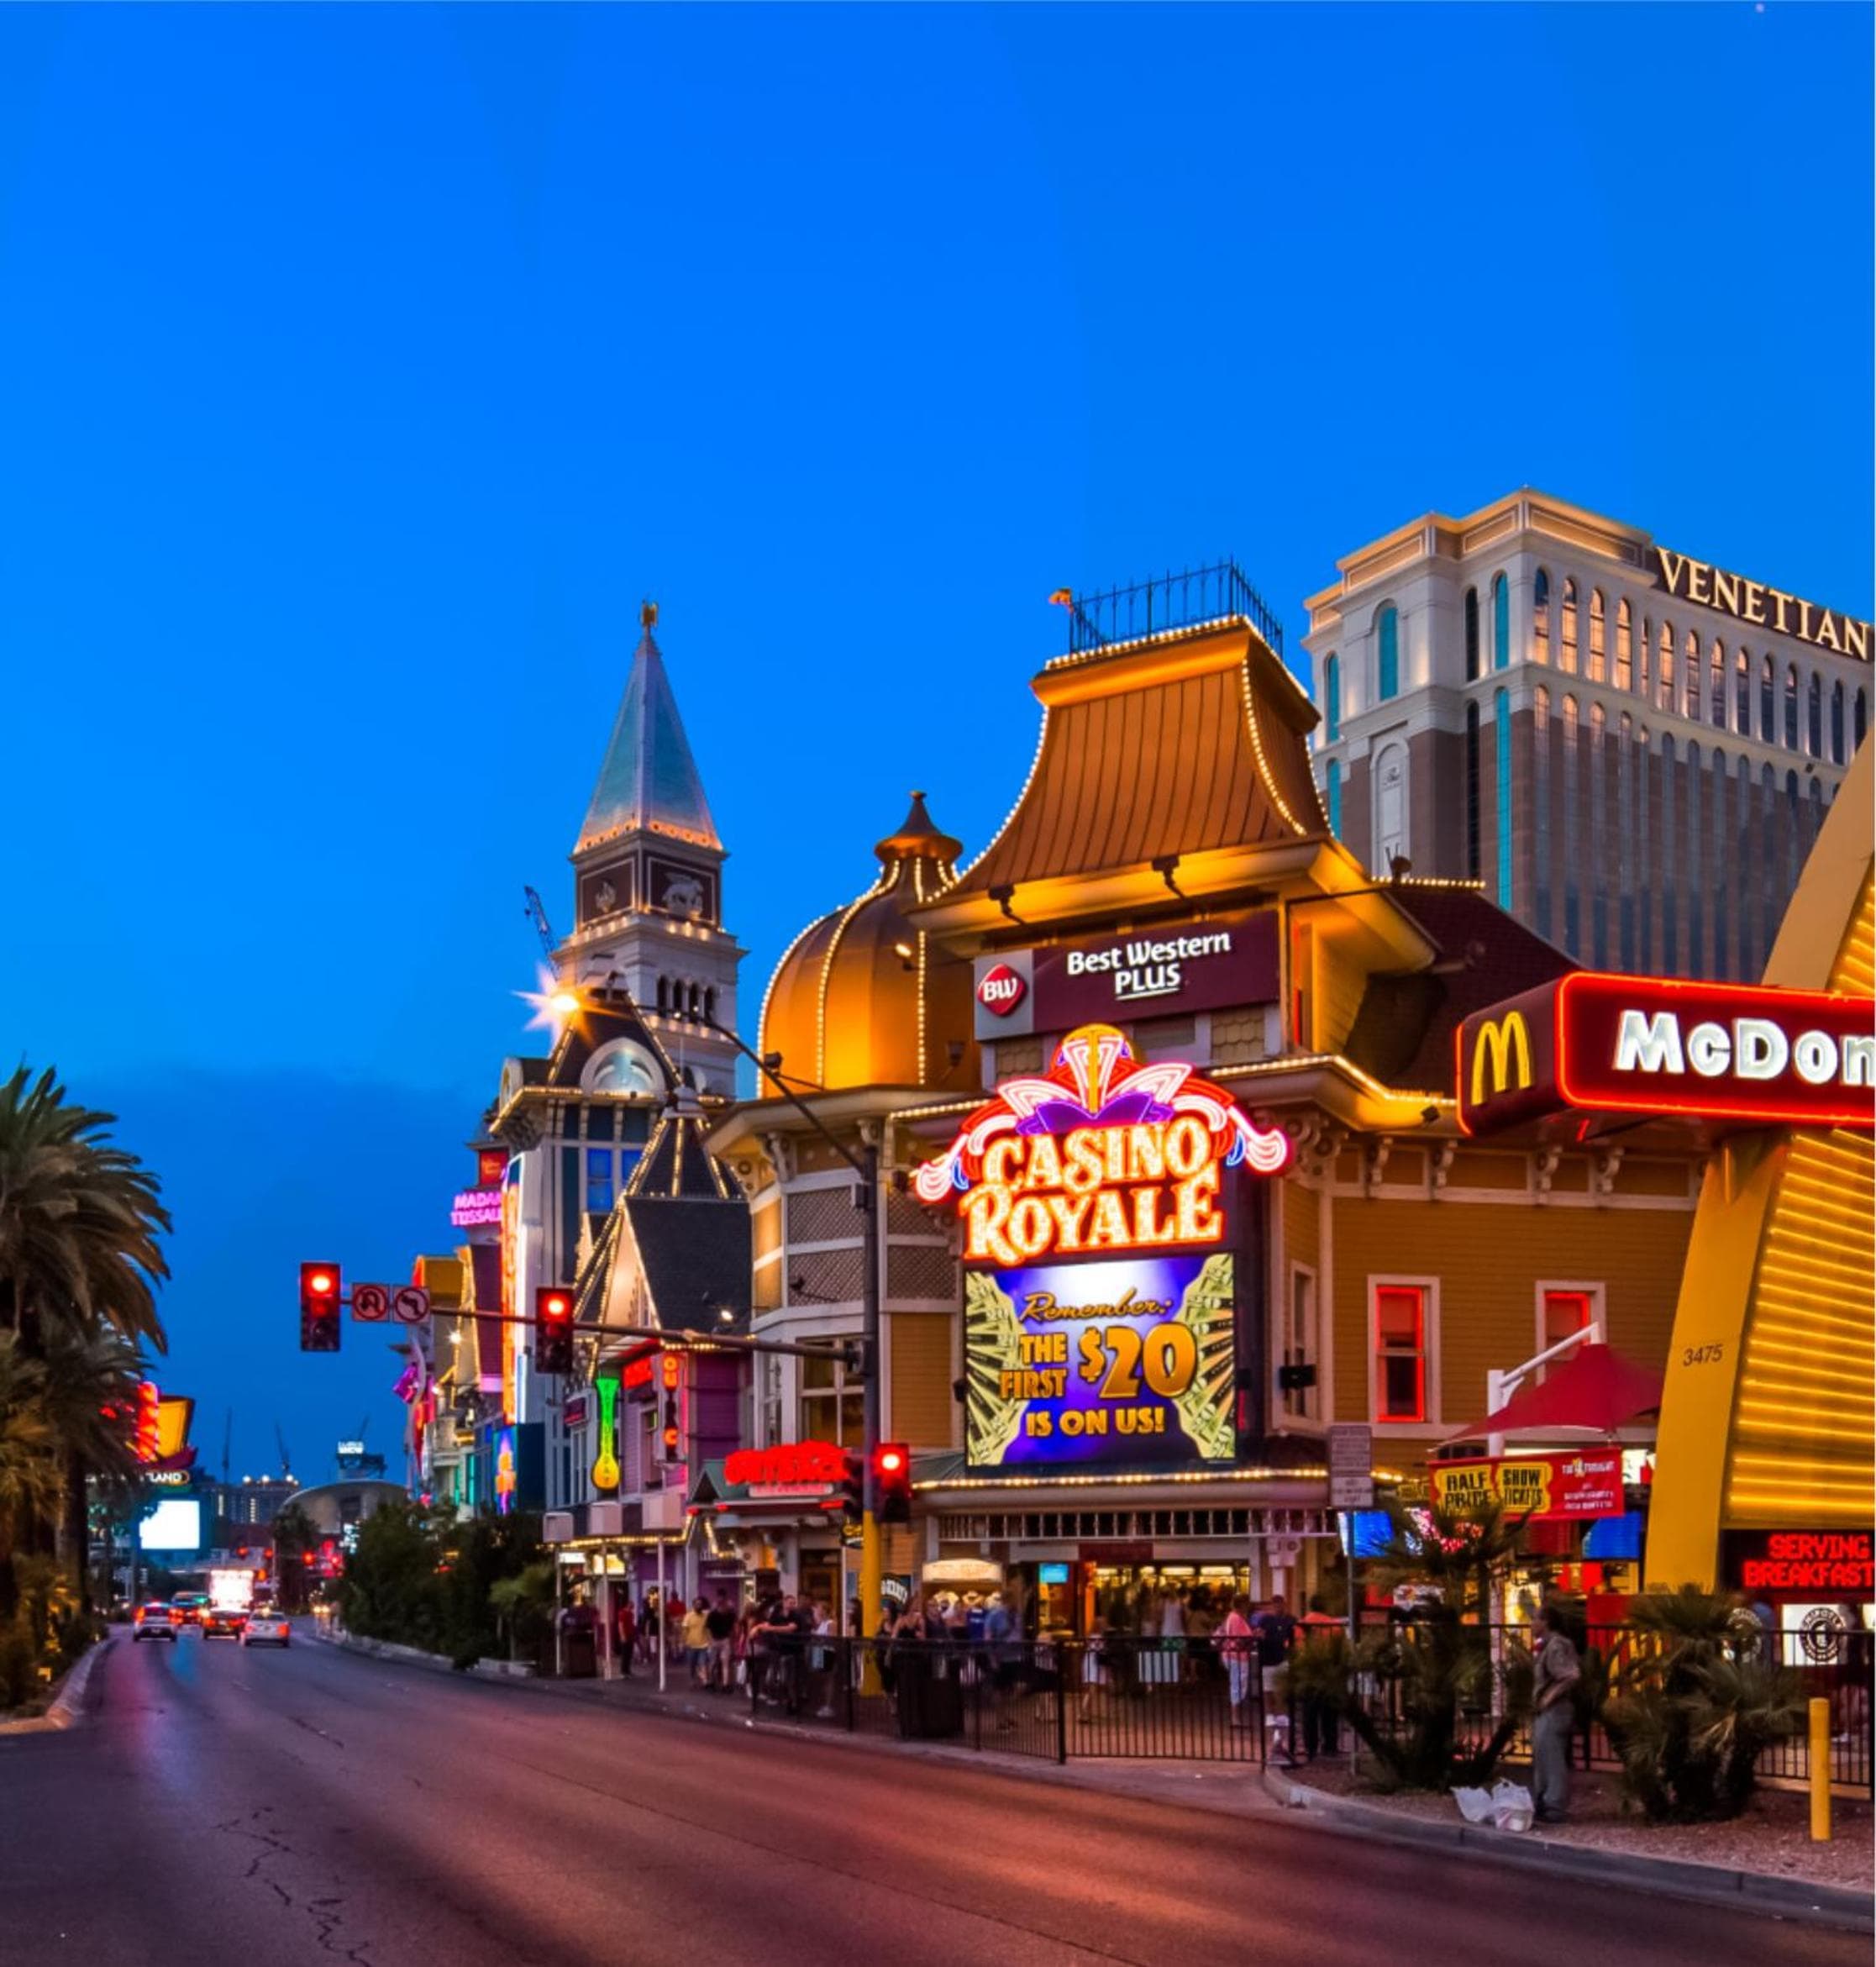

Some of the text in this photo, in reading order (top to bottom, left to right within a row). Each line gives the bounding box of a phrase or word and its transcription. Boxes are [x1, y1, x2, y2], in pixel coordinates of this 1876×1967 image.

[1656, 546, 1870, 661] VENETIAN
[1068, 933, 1231, 975] Best Western
[983, 977, 1018, 1002] BW
[1115, 965, 1180, 994] PLUS
[1612, 1009, 1874, 1086] McDon
[981, 1116, 1211, 1193] CASINO
[961, 1161, 1223, 1265] ROYALE
[1019, 1333, 1068, 1365] THE
[1079, 1322, 1198, 1399] $20
[1684, 1344, 1723, 1367] 3475
[1000, 1368, 1068, 1399] FIRST
[1026, 1407, 1165, 1437] IS ON US!
[145, 1472, 182, 1484] LAND
[1447, 1471, 1488, 1491] HALF
[1502, 1469, 1540, 1483] SHOW
[1446, 1490, 1490, 1510] PRICE
[1503, 1488, 1542, 1507] TICKETS
[1768, 1533, 1870, 1559] SERVING
[1743, 1560, 1874, 1587] BREAKFAST
